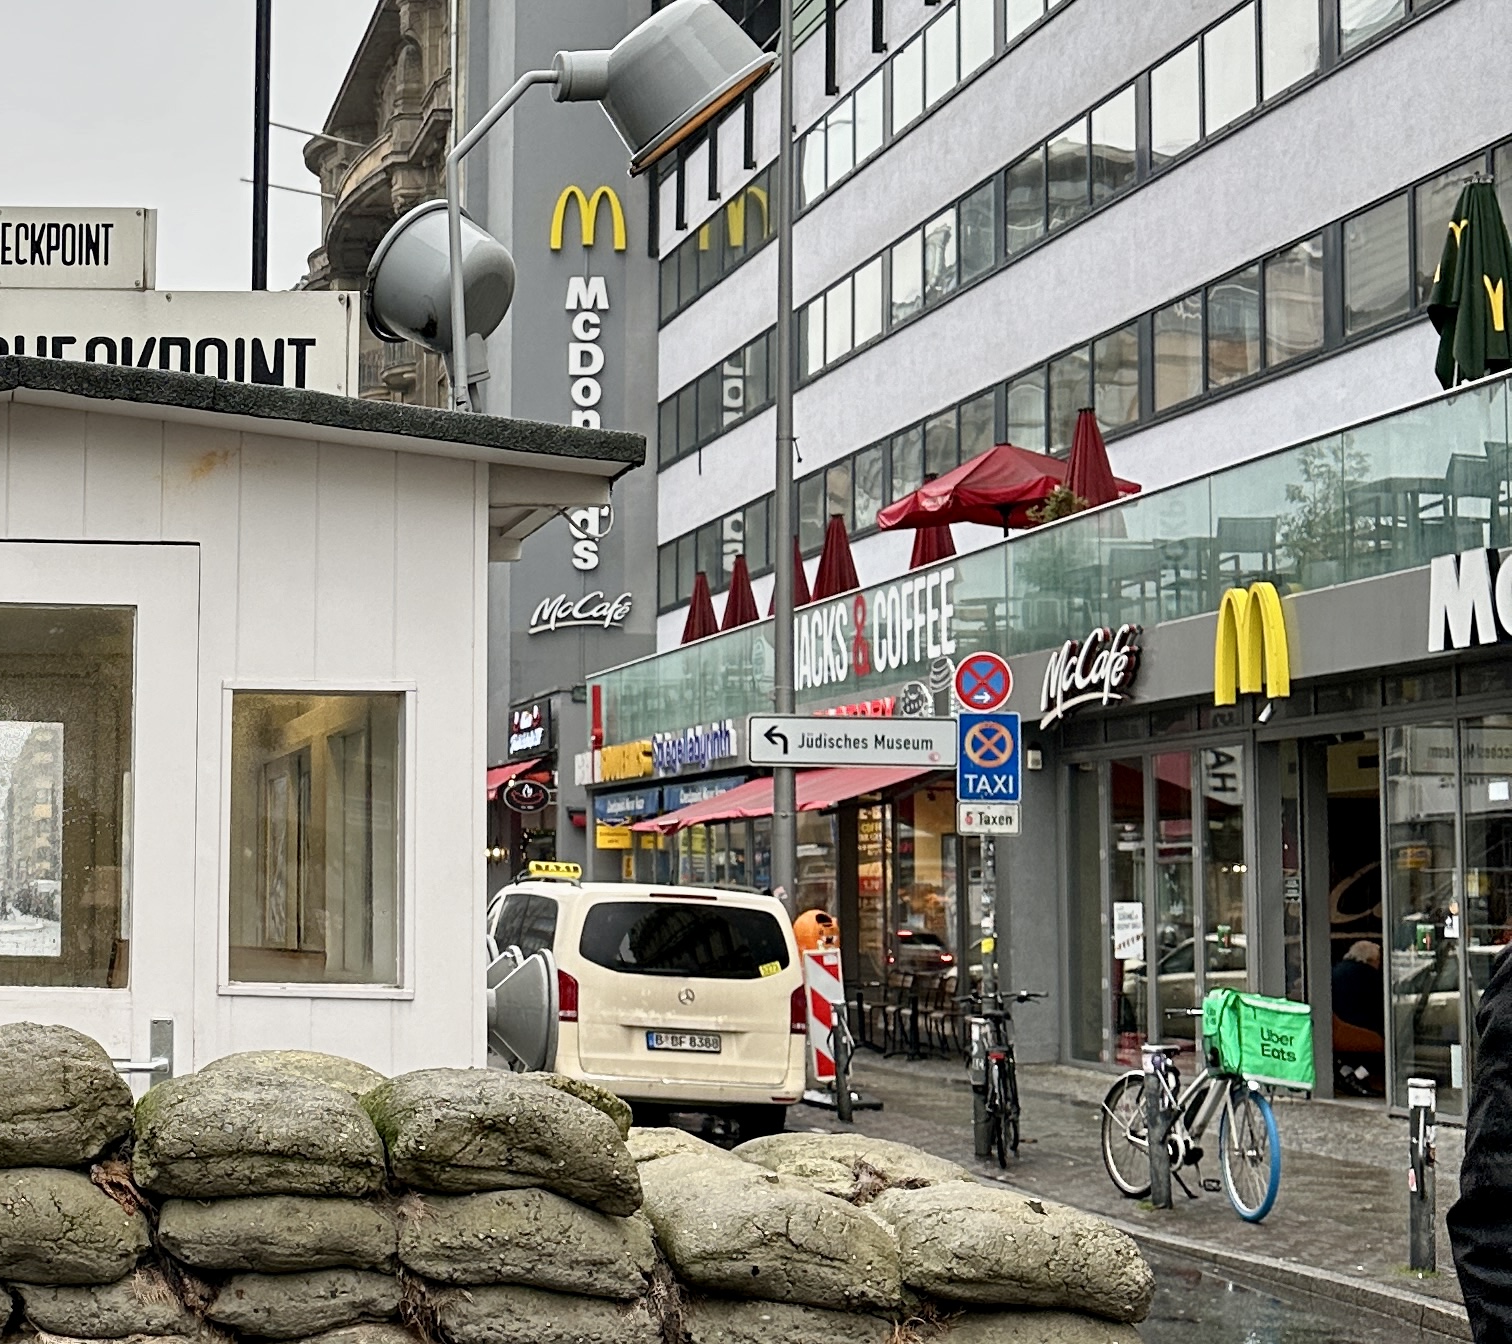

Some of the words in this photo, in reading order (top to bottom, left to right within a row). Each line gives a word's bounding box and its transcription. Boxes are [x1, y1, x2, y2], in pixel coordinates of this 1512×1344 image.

[564, 276, 610, 570] McDond's
[794, 602, 848, 691] ACKS
[853, 594, 870, 677] &
[873, 567, 955, 673] COFFEE
[798, 732, 868, 750] Jüdisches
[874, 733, 933, 750] Museum
[964, 774, 1014, 795] TAXI
[978, 812, 1013, 827] Taxen
[655, 1034, 665, 1046] B
[1260, 1026, 1295, 1047] Uber
[1260, 1043, 1297, 1063] Eats
